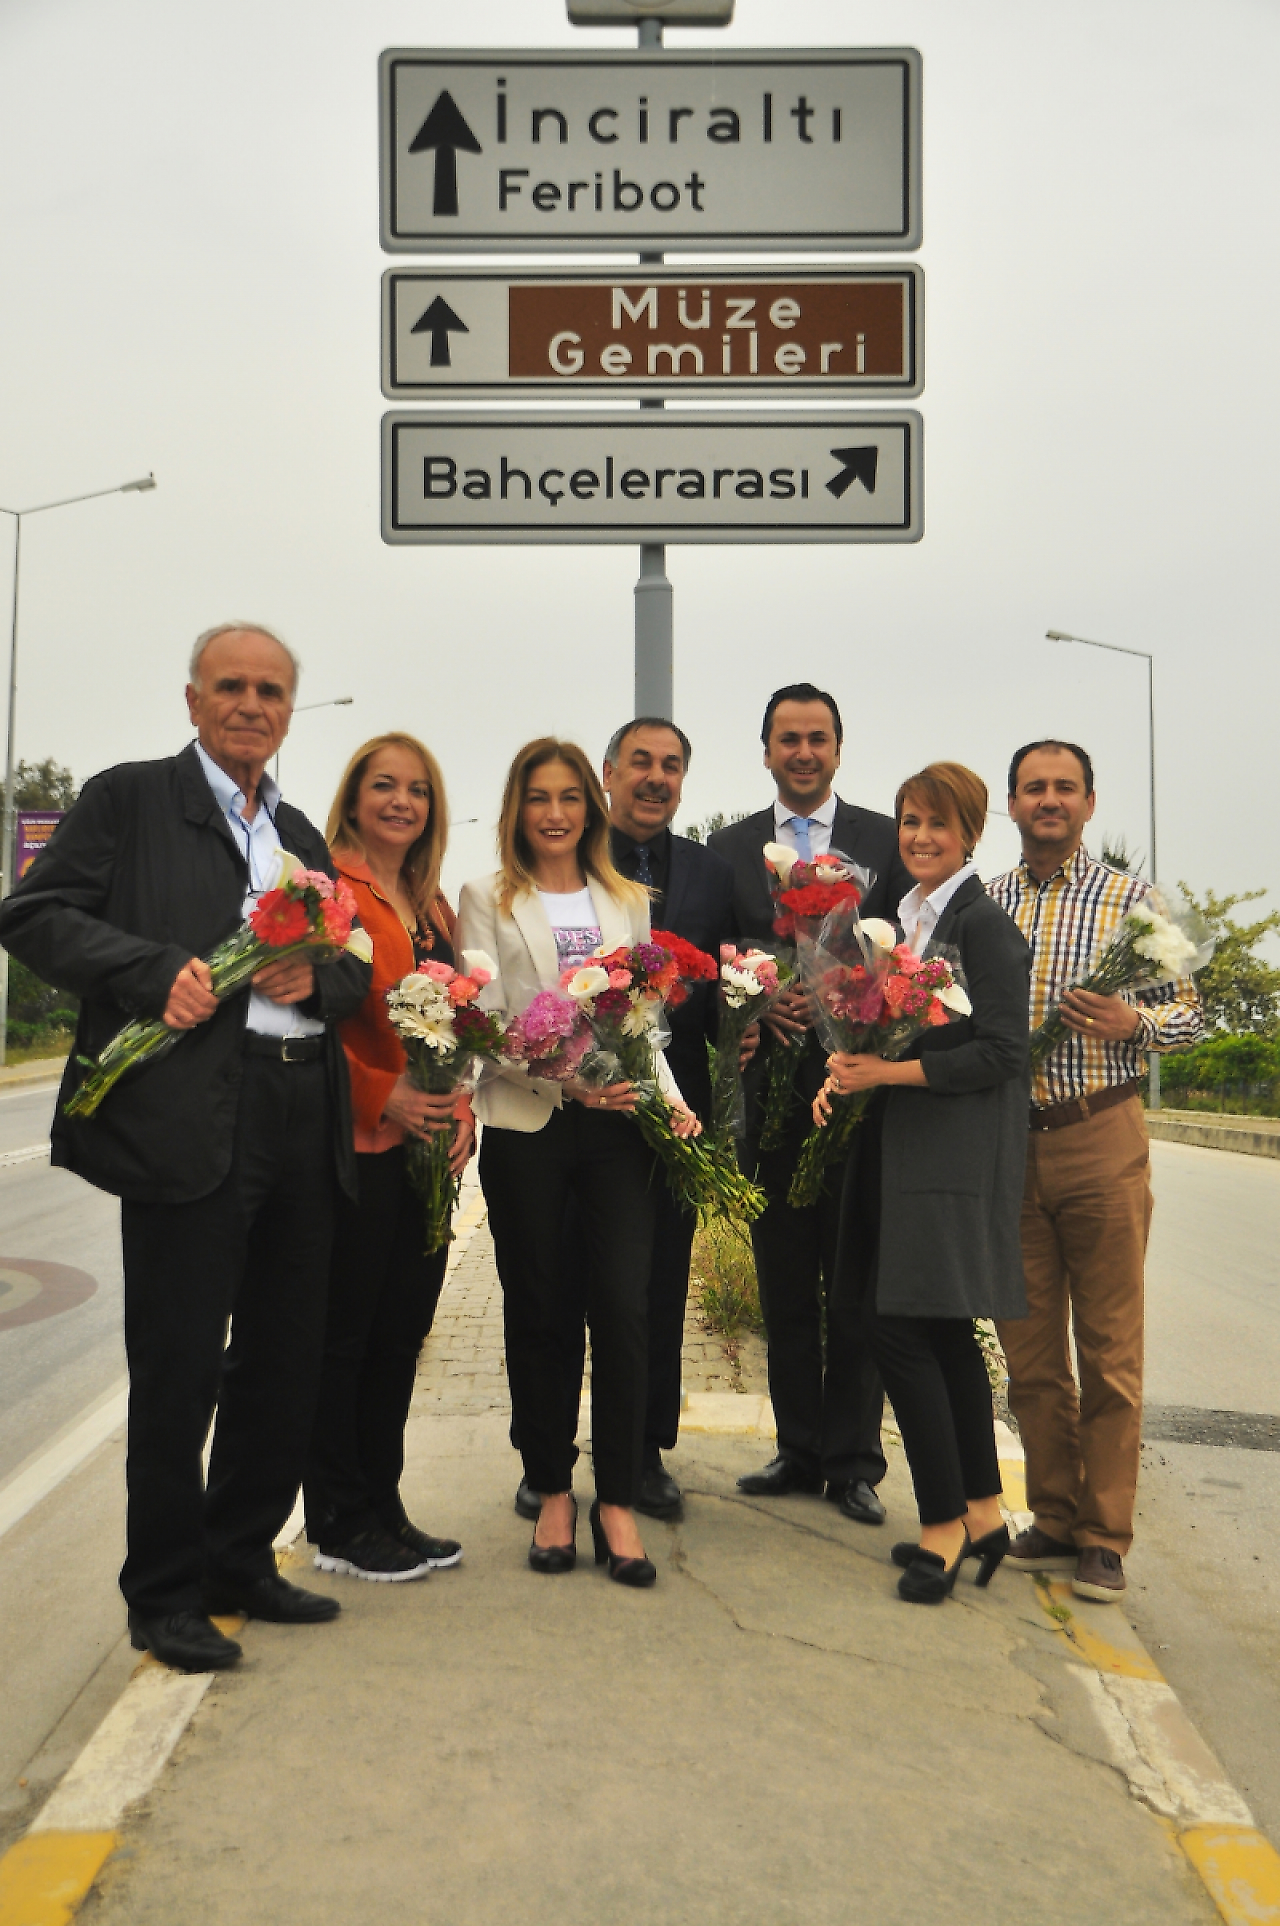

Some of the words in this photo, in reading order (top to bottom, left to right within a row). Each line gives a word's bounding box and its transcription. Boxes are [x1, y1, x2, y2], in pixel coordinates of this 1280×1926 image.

[496, 77, 841, 144] İnciraltı
[498, 169, 705, 212] Feribot
[611, 287, 802, 329] Müze
[548, 331, 866, 375] Gemileri
[423, 455, 809, 507] Bahçelerarası
